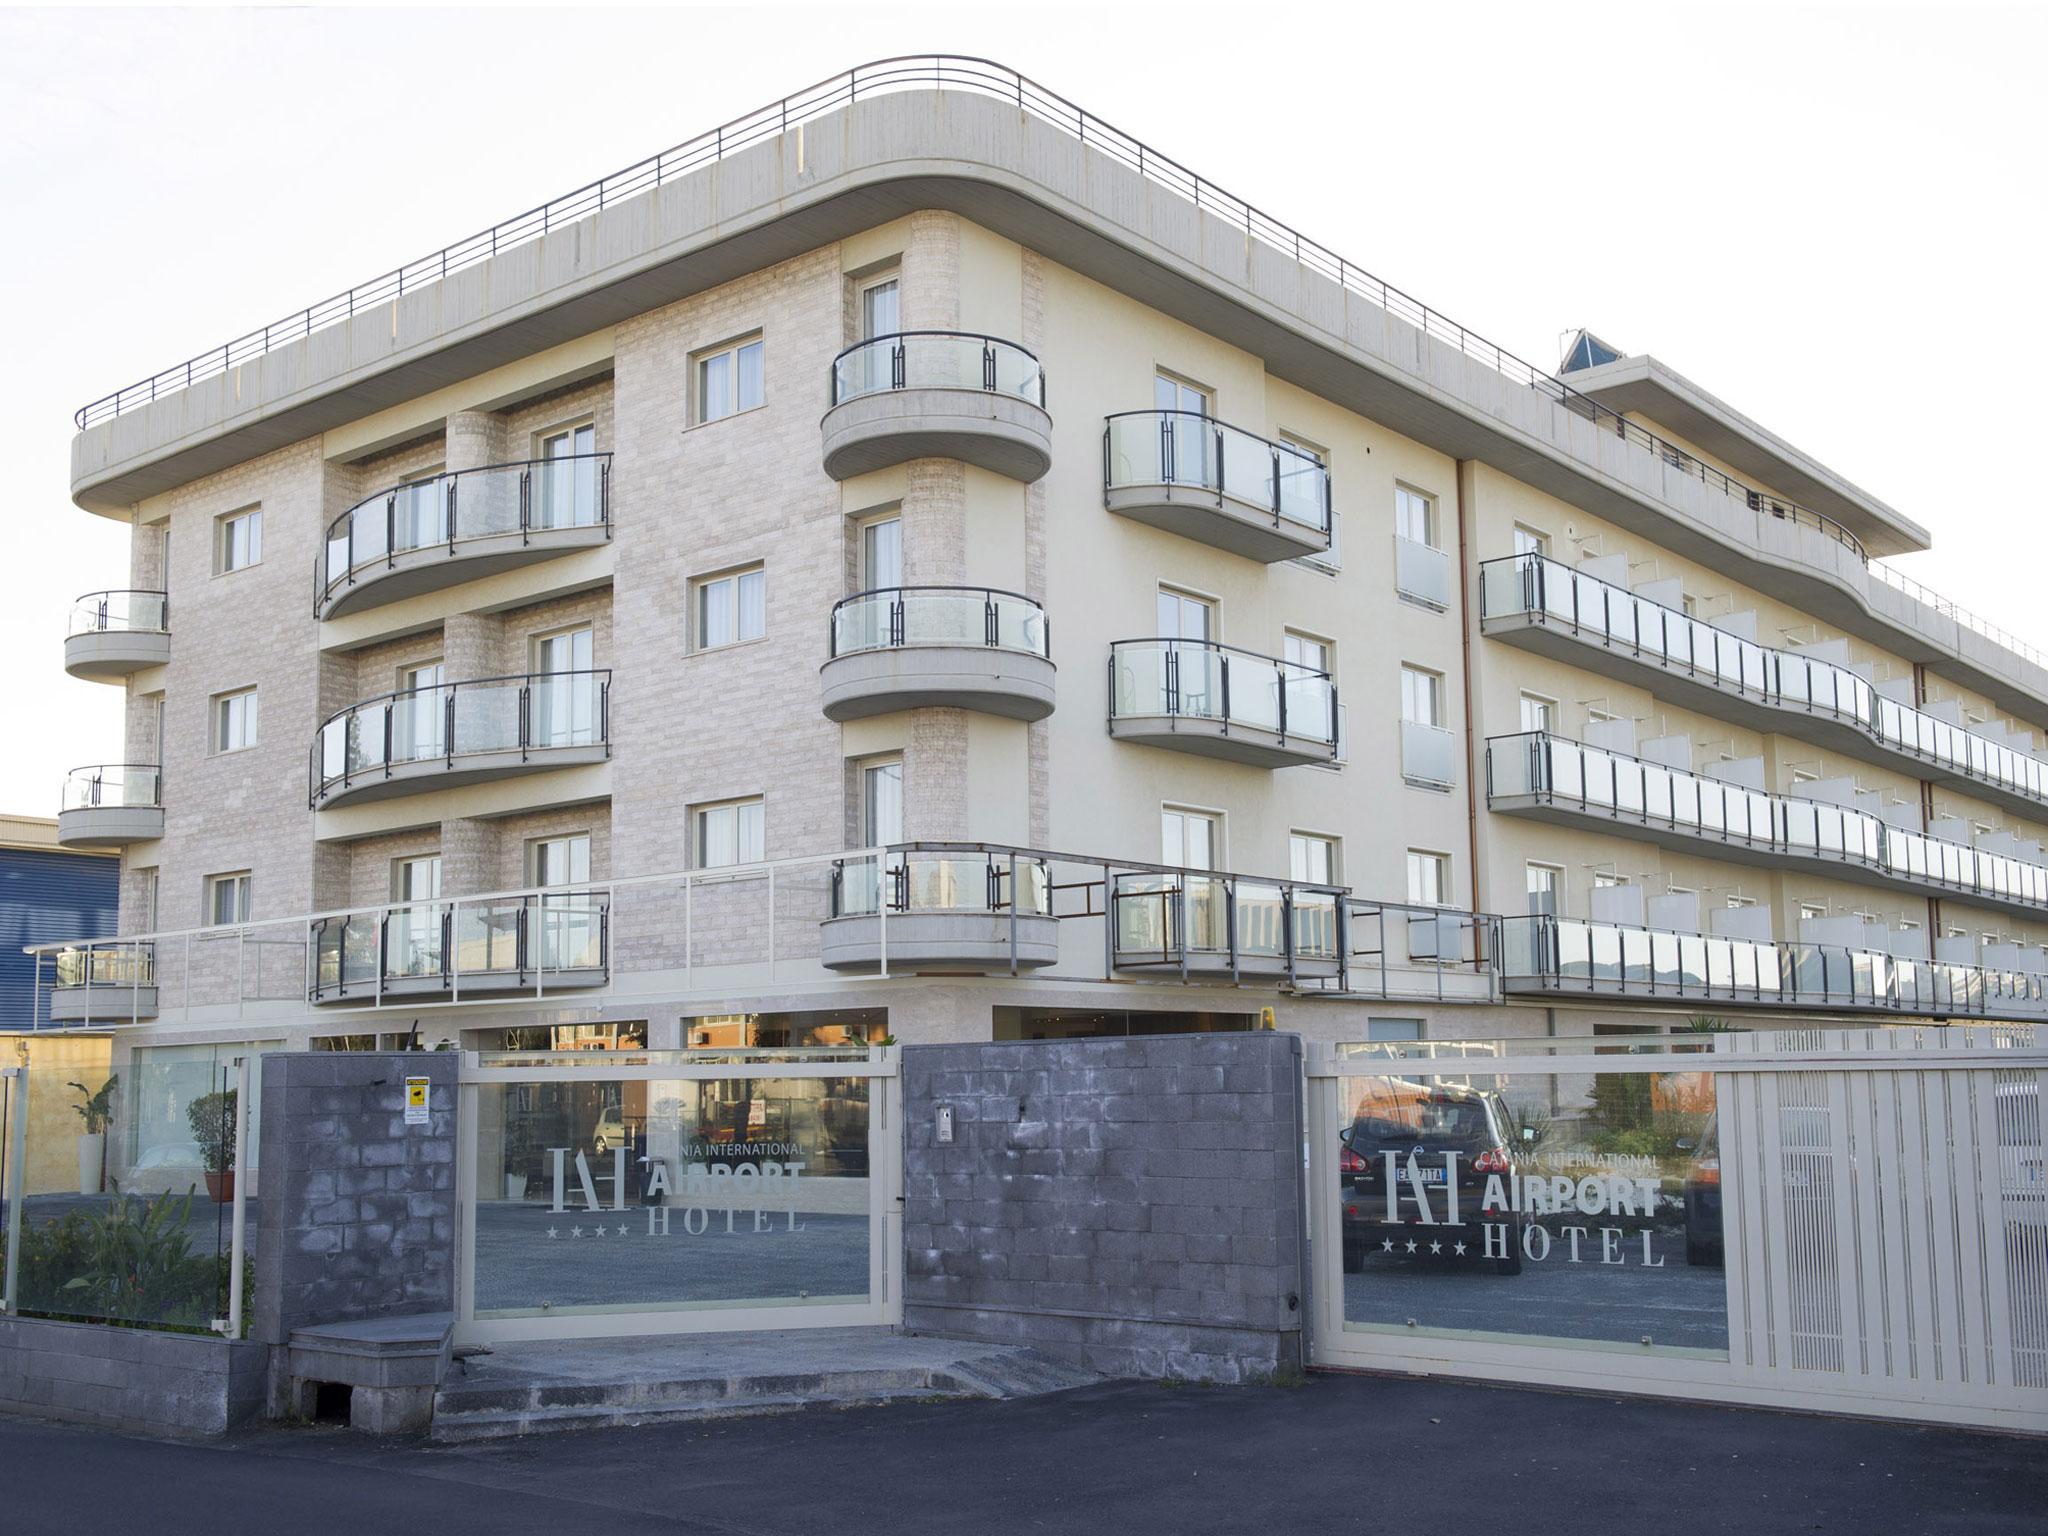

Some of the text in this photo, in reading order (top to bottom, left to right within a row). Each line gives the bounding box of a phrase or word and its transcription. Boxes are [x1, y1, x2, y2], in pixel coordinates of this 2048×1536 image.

[706, 1142, 806, 1157] INTERNATIONAL
[1545, 1151, 1661, 1170] NTERNATIONAL
[647, 1161, 806, 1196] AIRPORT
[1399, 1169, 1442, 1180] EA71TA
[1482, 1174, 1662, 1217] AIRPORT
[646, 1205, 806, 1236] HOTEL
[1481, 1222, 1665, 1267] HOTEL
